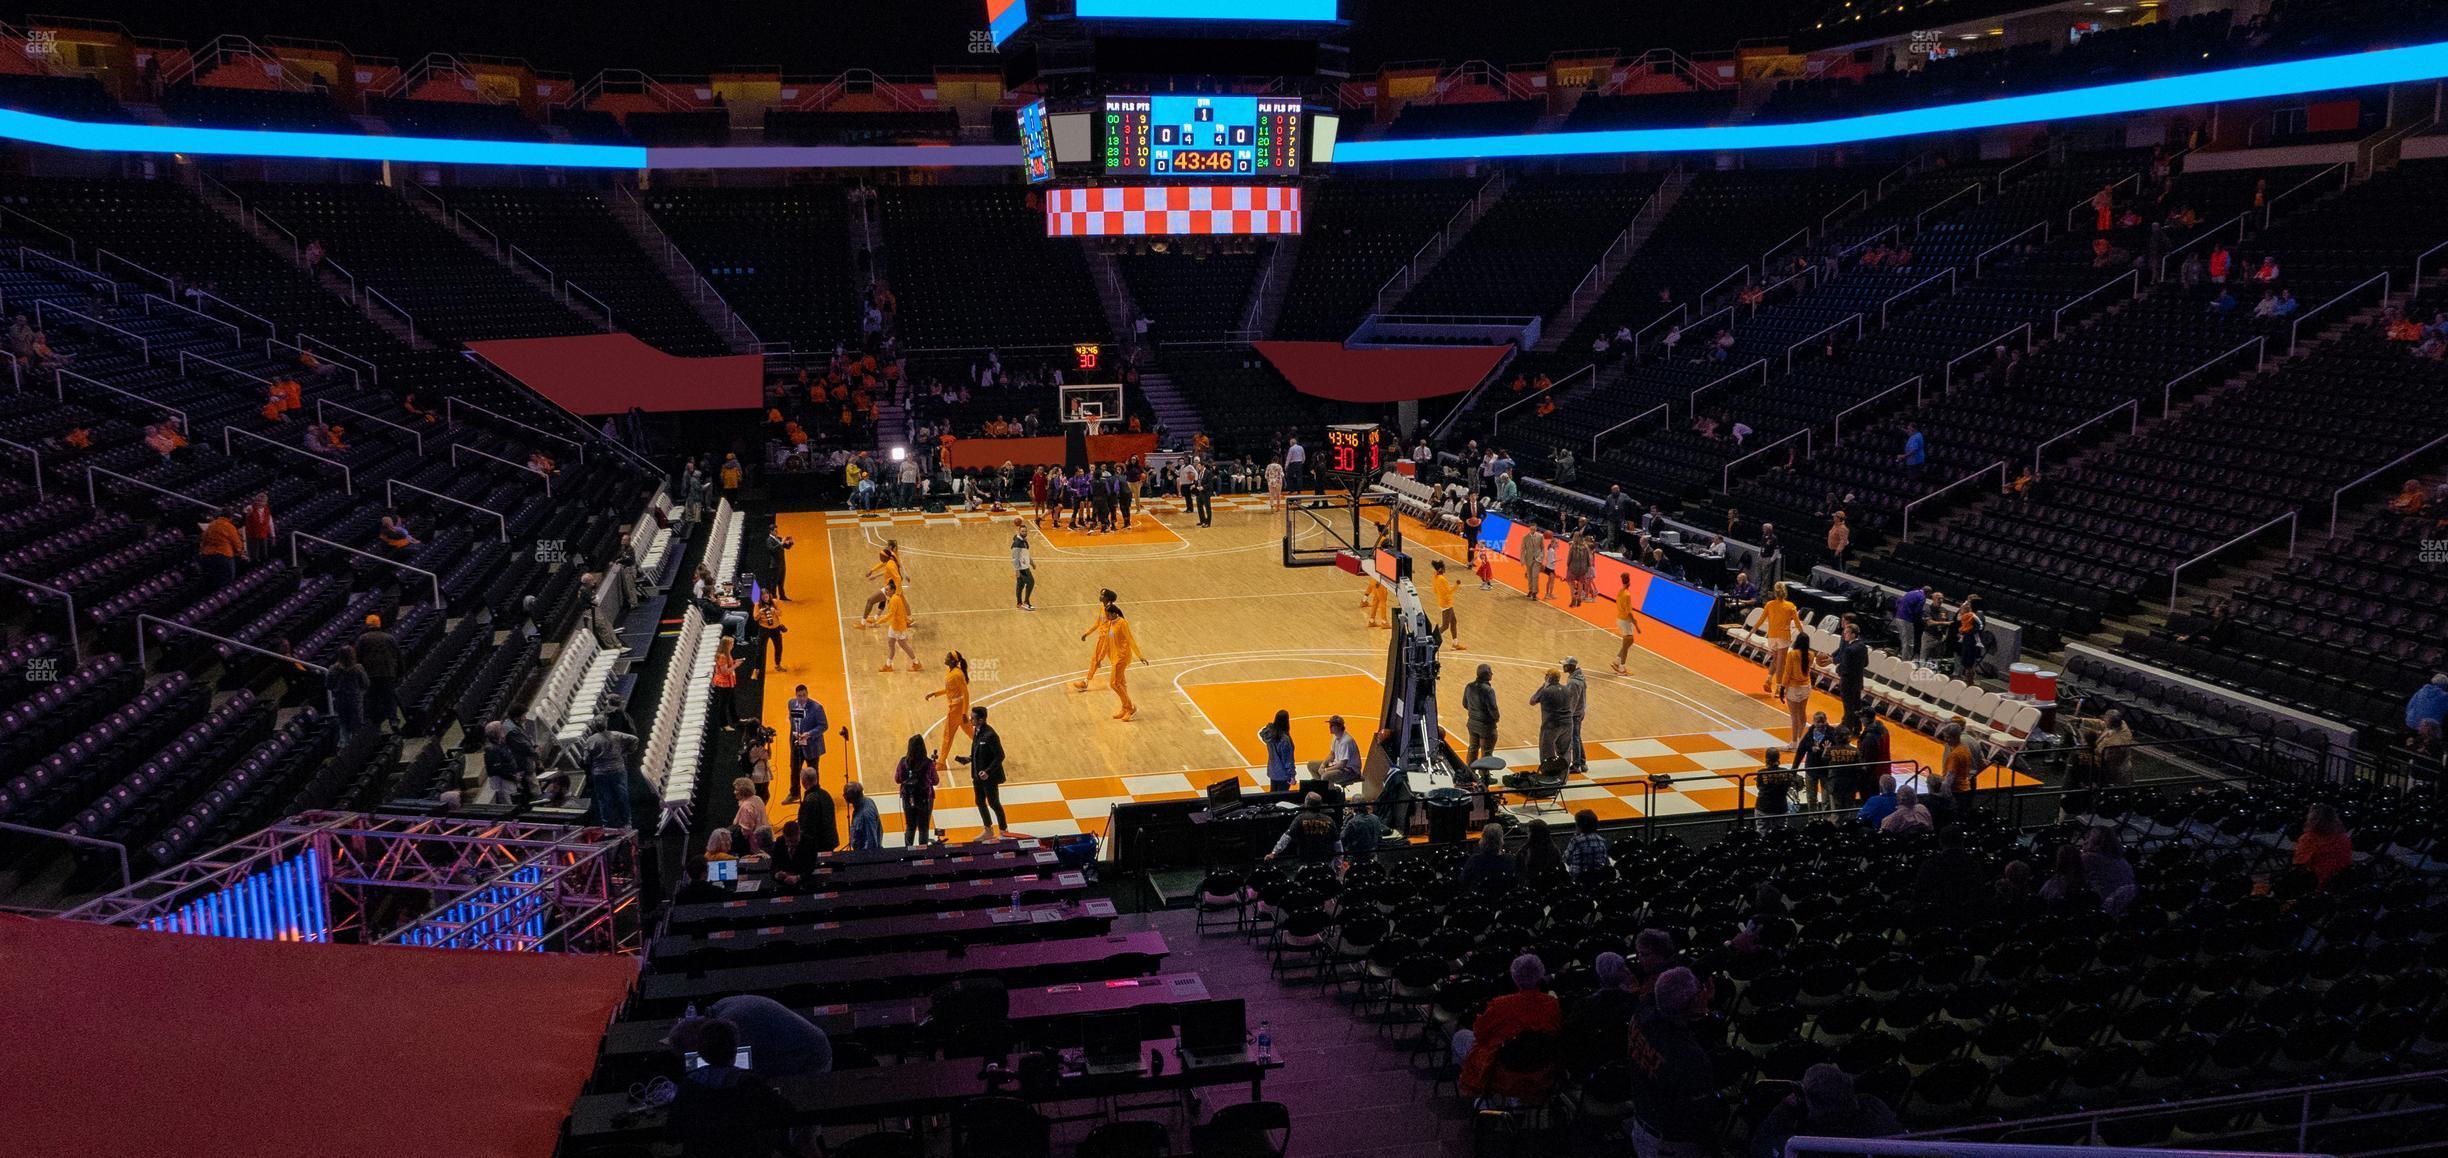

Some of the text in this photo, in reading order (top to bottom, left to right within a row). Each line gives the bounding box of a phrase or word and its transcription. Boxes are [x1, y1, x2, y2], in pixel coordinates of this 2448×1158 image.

[1106, 102, 1150, 111] PLR FLS PTS
[1259, 104, 1271, 112] PLR
[1107, 115, 1119, 123] 00
[1140, 115, 1146, 123] 9
[1202, 108, 1207, 121] 1
[1277, 116, 1283, 124] 0
[1289, 116, 1296, 125] 0
[1124, 125, 1130, 134] 3
[1138, 126, 1149, 134] 17
[1276, 126, 1283, 135] 0
[1289, 127, 1296, 135] 7
[1162, 128, 1170, 142] 0
[1185, 135, 1192, 144] 4
[1216, 135, 1222, 144] 4
[1237, 129, 1245, 143] 0
[1108, 137, 1119, 145] 13
[1140, 137, 1146, 145] 8
[1276, 137, 1282, 145] 2
[1289, 138, 1296, 146] 7
[1107, 147, 1119, 156] 23
[1138, 147, 1149, 156] 10
[1258, 148, 1268, 156] 21
[1288, 148, 1295, 156] 2
[1107, 157, 1146, 167] 33 0 0
[1174, 152, 1232, 169] 43:46
[1275, 158, 1281, 166] 0
[1288, 158, 1295, 167] 0
[1158, 161, 1165, 170] 0
[1240, 161, 1247, 170] 0
[1076, 346, 1098, 354] 43:46
[1080, 355, 1095, 368] 30
[1328, 432, 1359, 447] 43:46
[1334, 446, 1354, 471] 30
